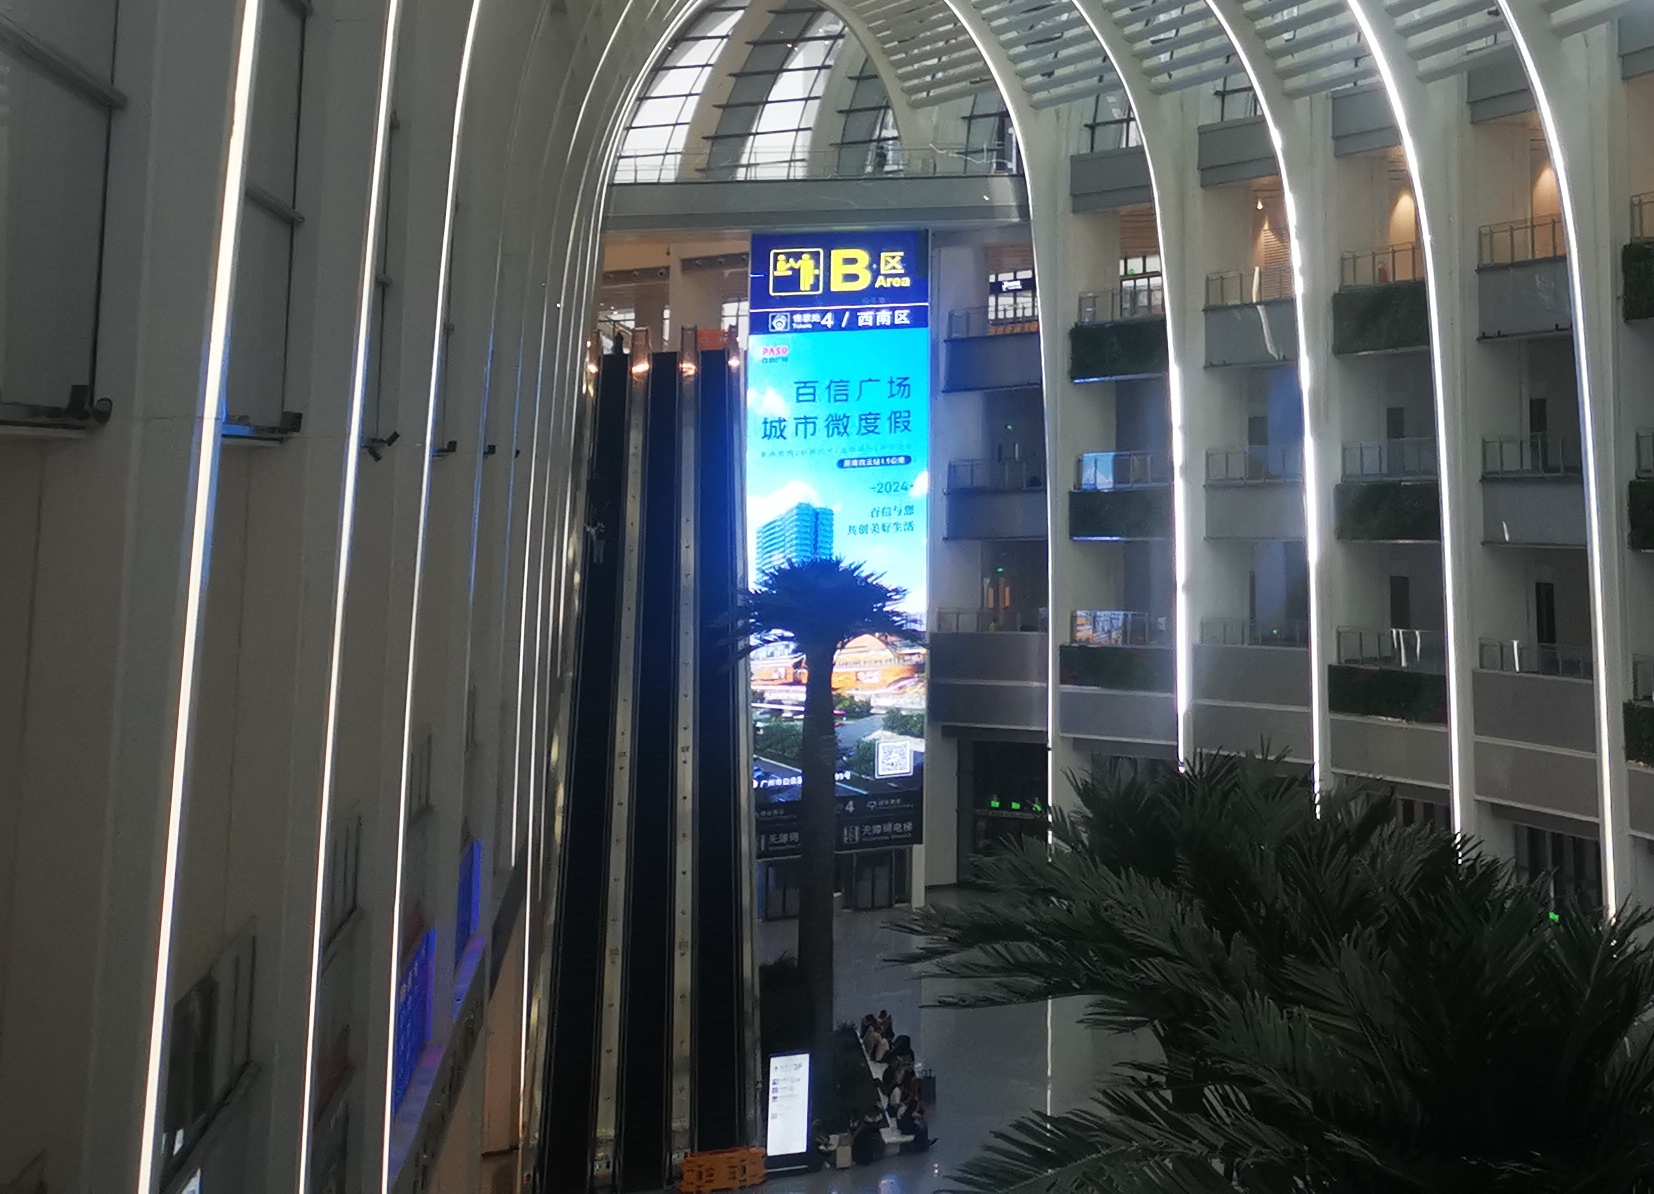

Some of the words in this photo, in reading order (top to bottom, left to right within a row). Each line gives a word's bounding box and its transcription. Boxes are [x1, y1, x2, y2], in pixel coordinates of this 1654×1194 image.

[830, 249, 871, 292] B
[880, 251, 905, 274] 区
[875, 276, 911, 289] Area
[820, 312, 835, 328] 4
[857, 310, 911, 326] 西南区
[794, 376, 911, 404] 百信广场
[761, 409, 912, 440] 城市微度假
